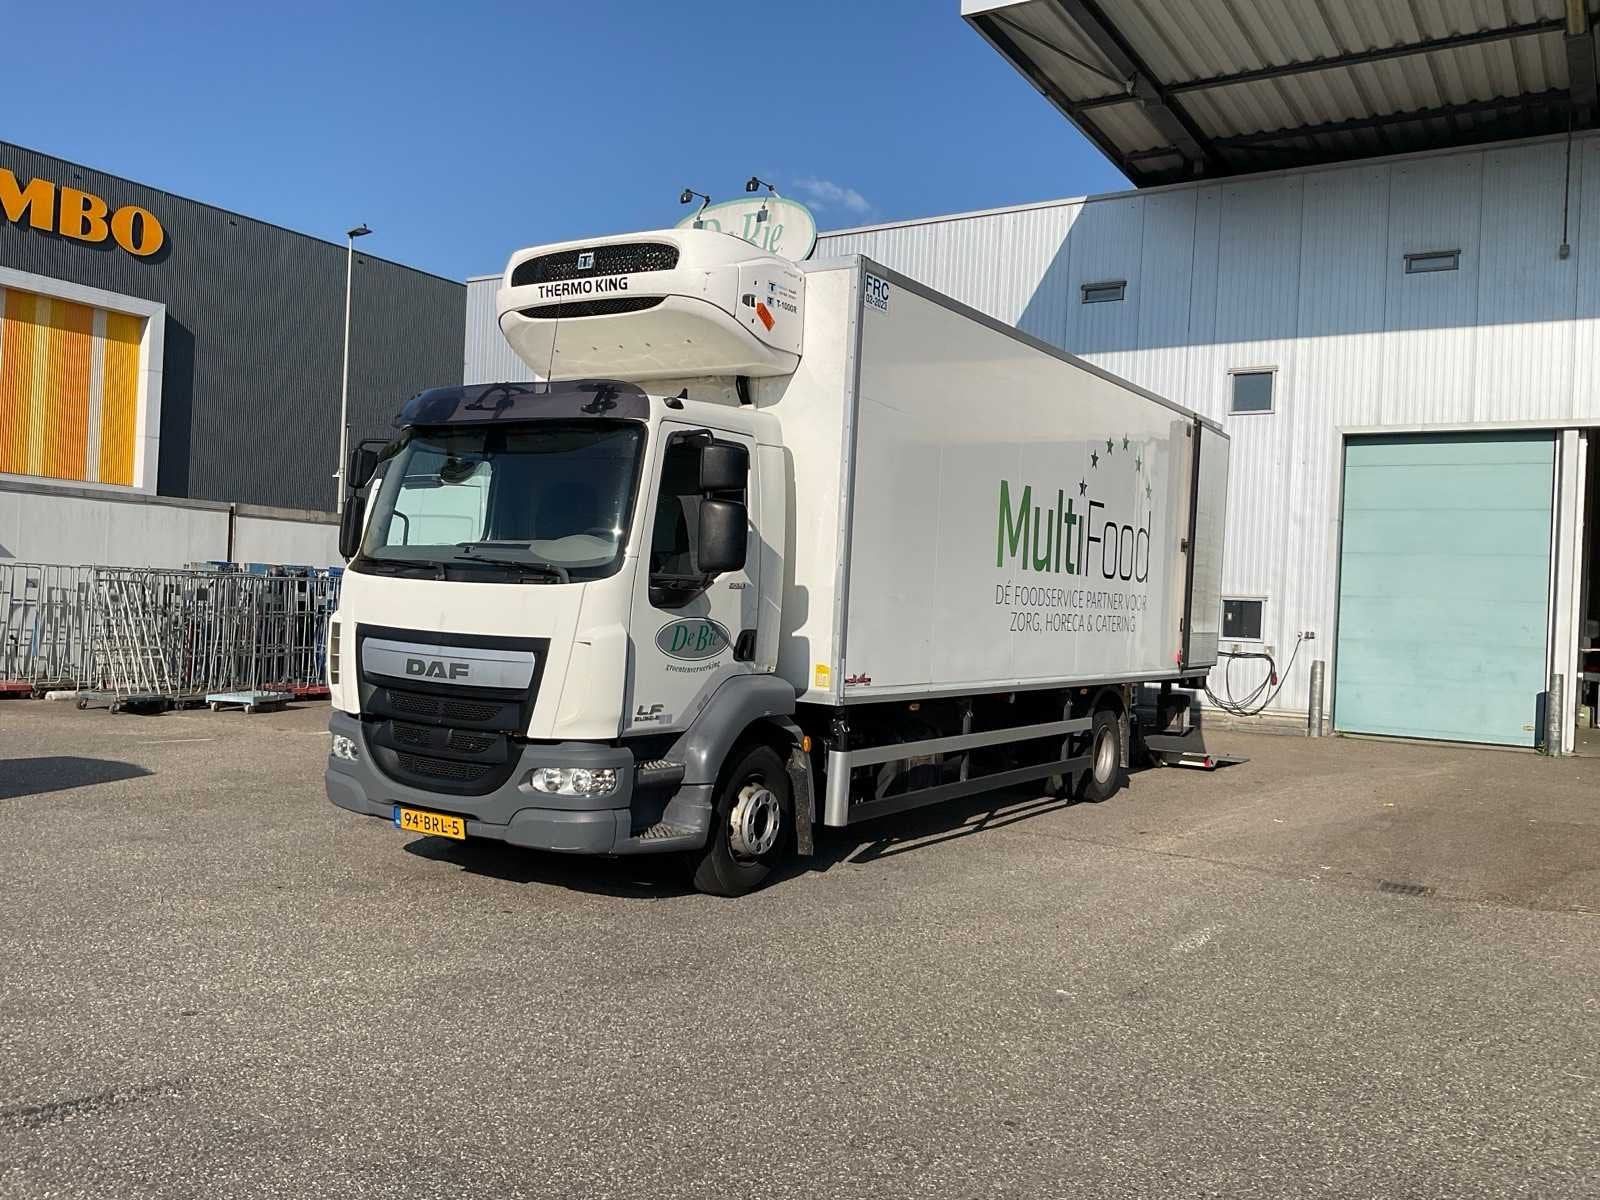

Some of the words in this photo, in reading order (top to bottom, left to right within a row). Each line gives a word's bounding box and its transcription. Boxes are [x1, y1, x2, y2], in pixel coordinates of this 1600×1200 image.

[538, 280, 592, 298] THERMO
[595, 277, 628, 293] KING
[866, 274, 889, 301] FRC
[996, 479, 1152, 583] MultiFood
[995, 580, 1012, 605] DÉ
[1014, 585, 1084, 609] FOODSERVICE
[1086, 590, 1124, 610] PARTNER
[1009, 611, 1043, 634] ZORG,
[1045, 612, 1085, 632] HORECA
[1095, 614, 1136, 632] CATERING
[406, 658, 469, 680] DAF
[636, 703, 665, 716] LF
[404, 812, 461, 836] 94-BRL-5
